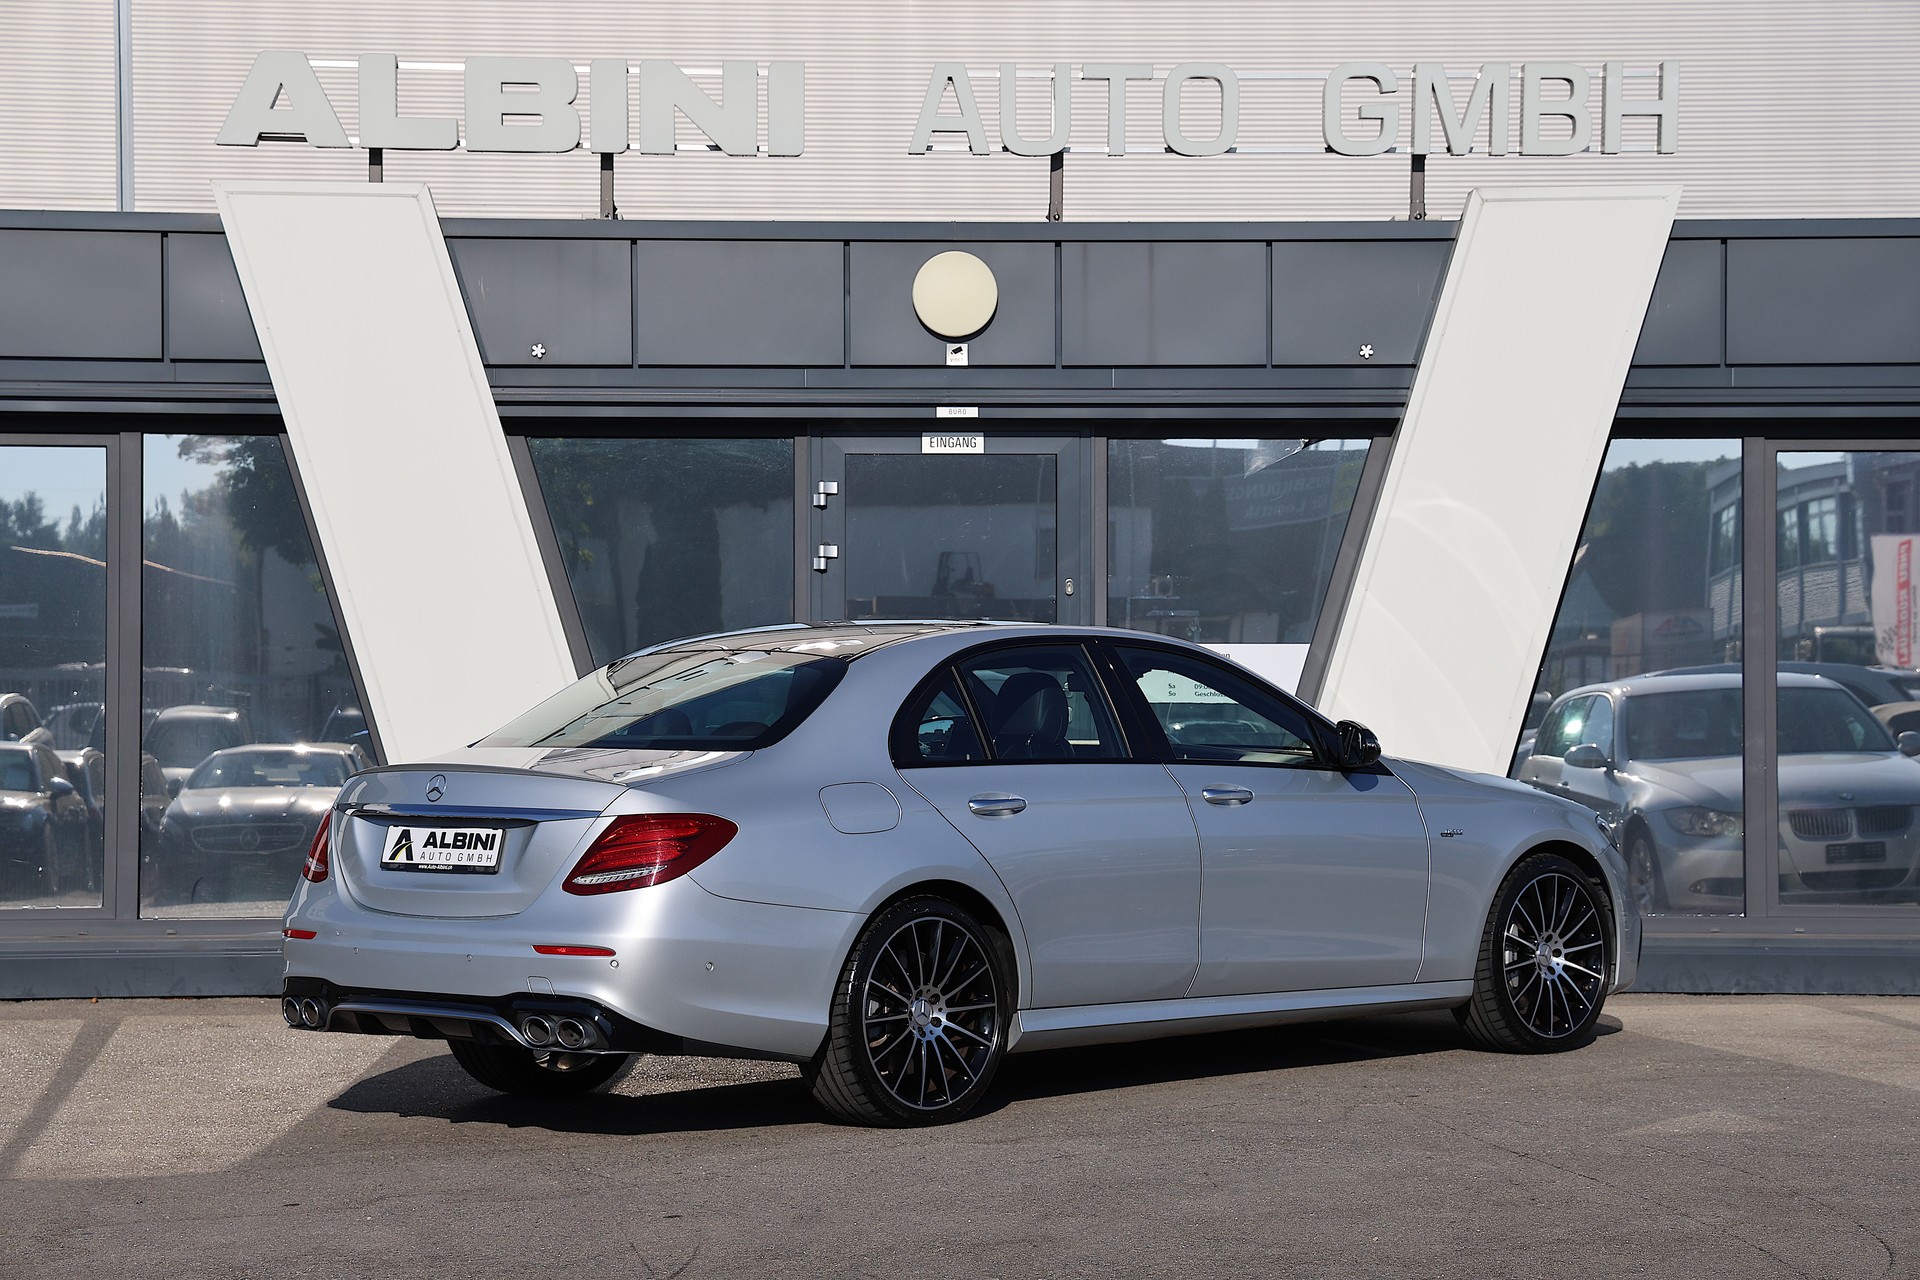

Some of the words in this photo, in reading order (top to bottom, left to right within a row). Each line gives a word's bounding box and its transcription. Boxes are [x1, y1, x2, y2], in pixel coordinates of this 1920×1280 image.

[216, 51, 805, 157] ALBINI
[908, 62, 1241, 156] AUTO
[1322, 61, 1682, 156] GMBH
[929, 437, 977, 448] EINGANG
[423, 831, 497, 851] ALBINI
[420, 851, 452, 862] AUTO
[457, 852, 493, 863] GMBH
